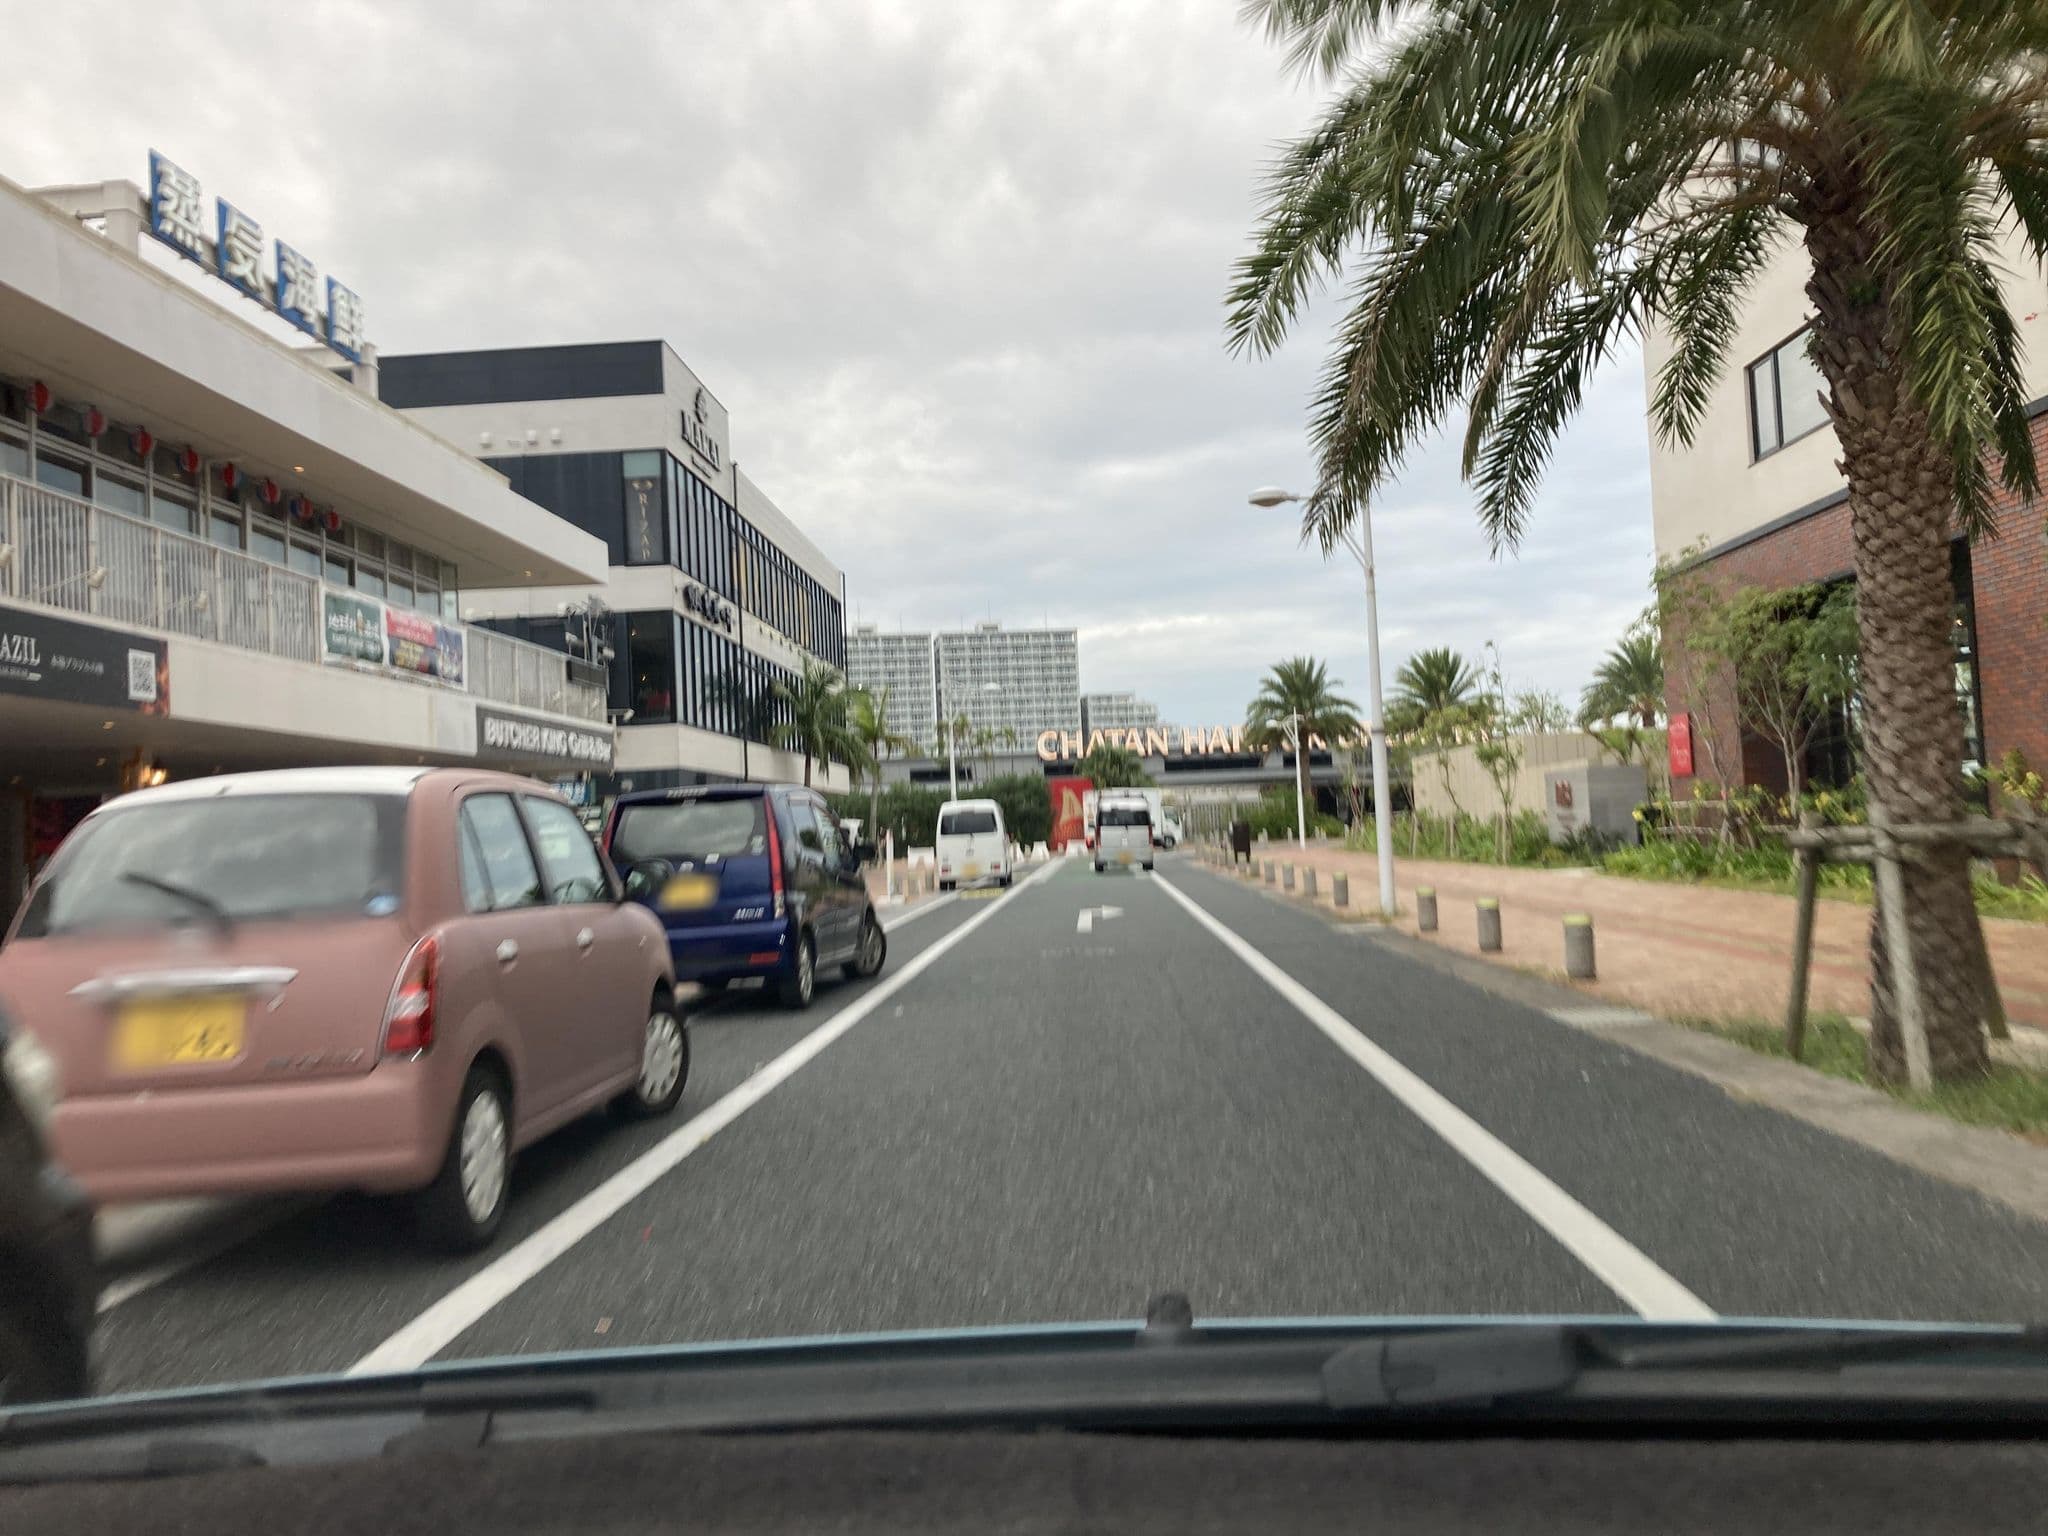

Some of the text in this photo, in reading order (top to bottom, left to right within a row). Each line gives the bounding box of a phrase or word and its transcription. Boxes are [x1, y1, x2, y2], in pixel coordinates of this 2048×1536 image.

[484, 717, 541, 752] BUTCHER
[541, 727, 567, 757] KING
[1037, 727, 1169, 761] CHATAN
